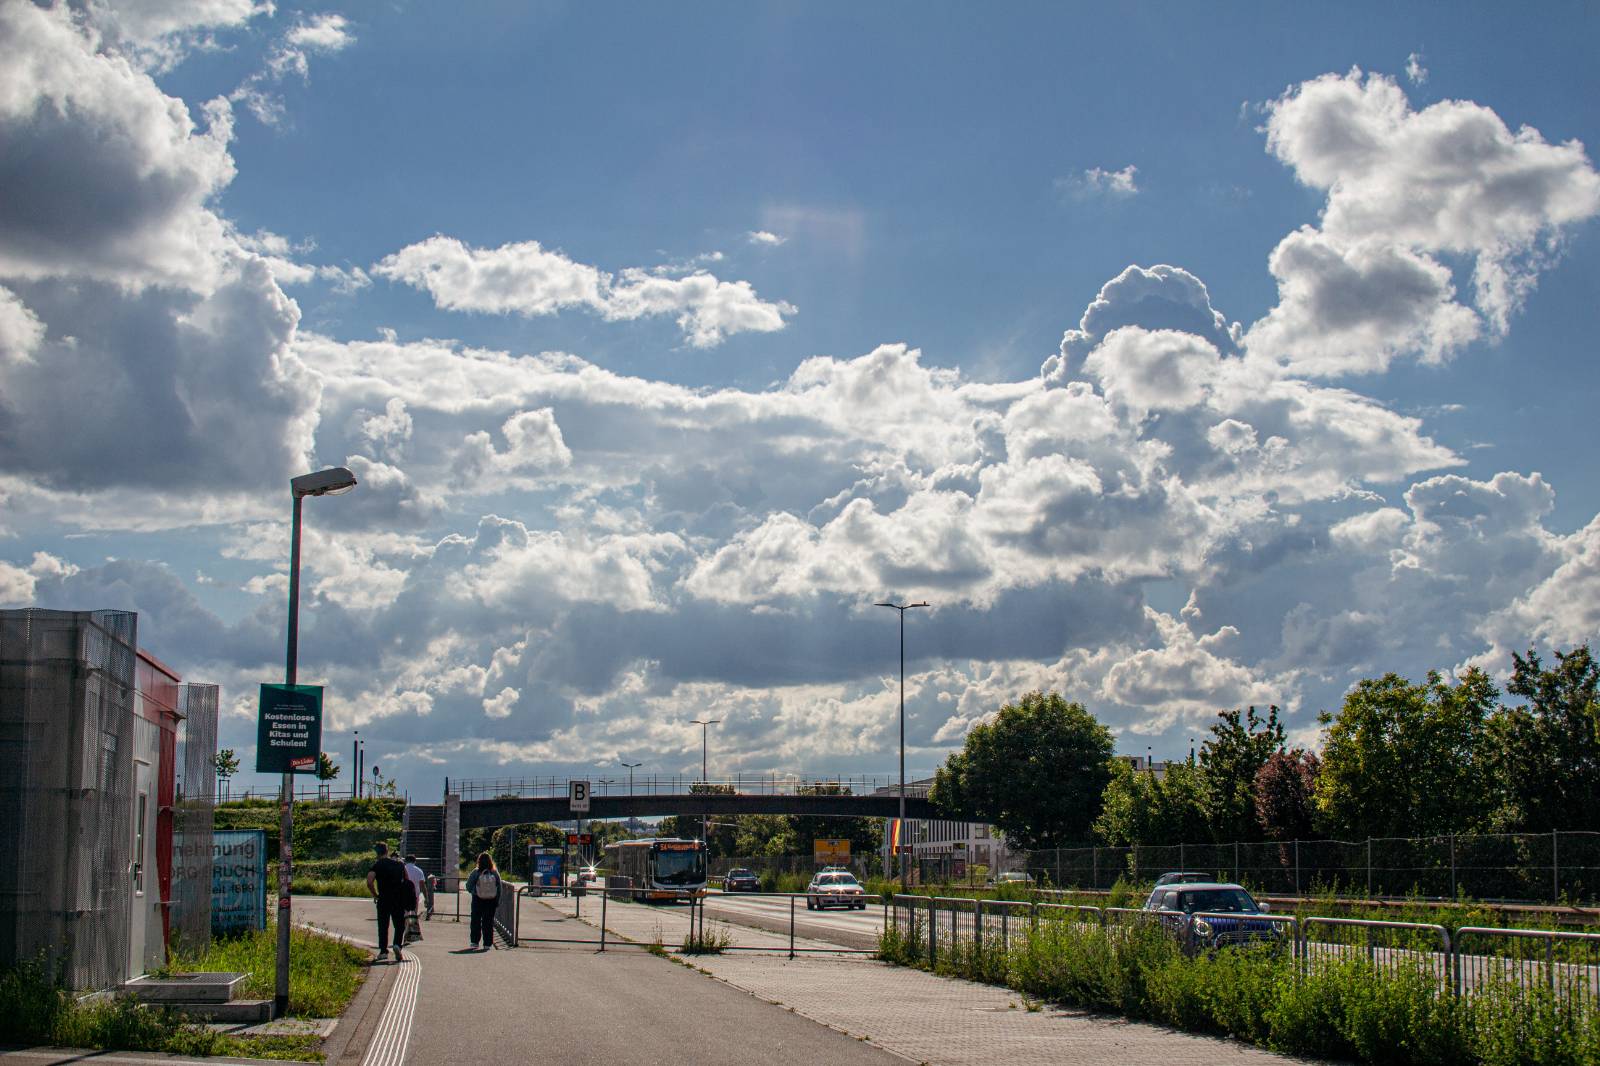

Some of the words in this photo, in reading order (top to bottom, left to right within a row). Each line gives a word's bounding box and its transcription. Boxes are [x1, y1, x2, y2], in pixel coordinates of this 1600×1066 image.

[264, 713, 315, 721] Kostenloses
[298, 722, 306, 730] in
[269, 730, 291, 738] Kitas
[270, 739, 307, 747] Schulen!
[575, 783, 585, 801] B
